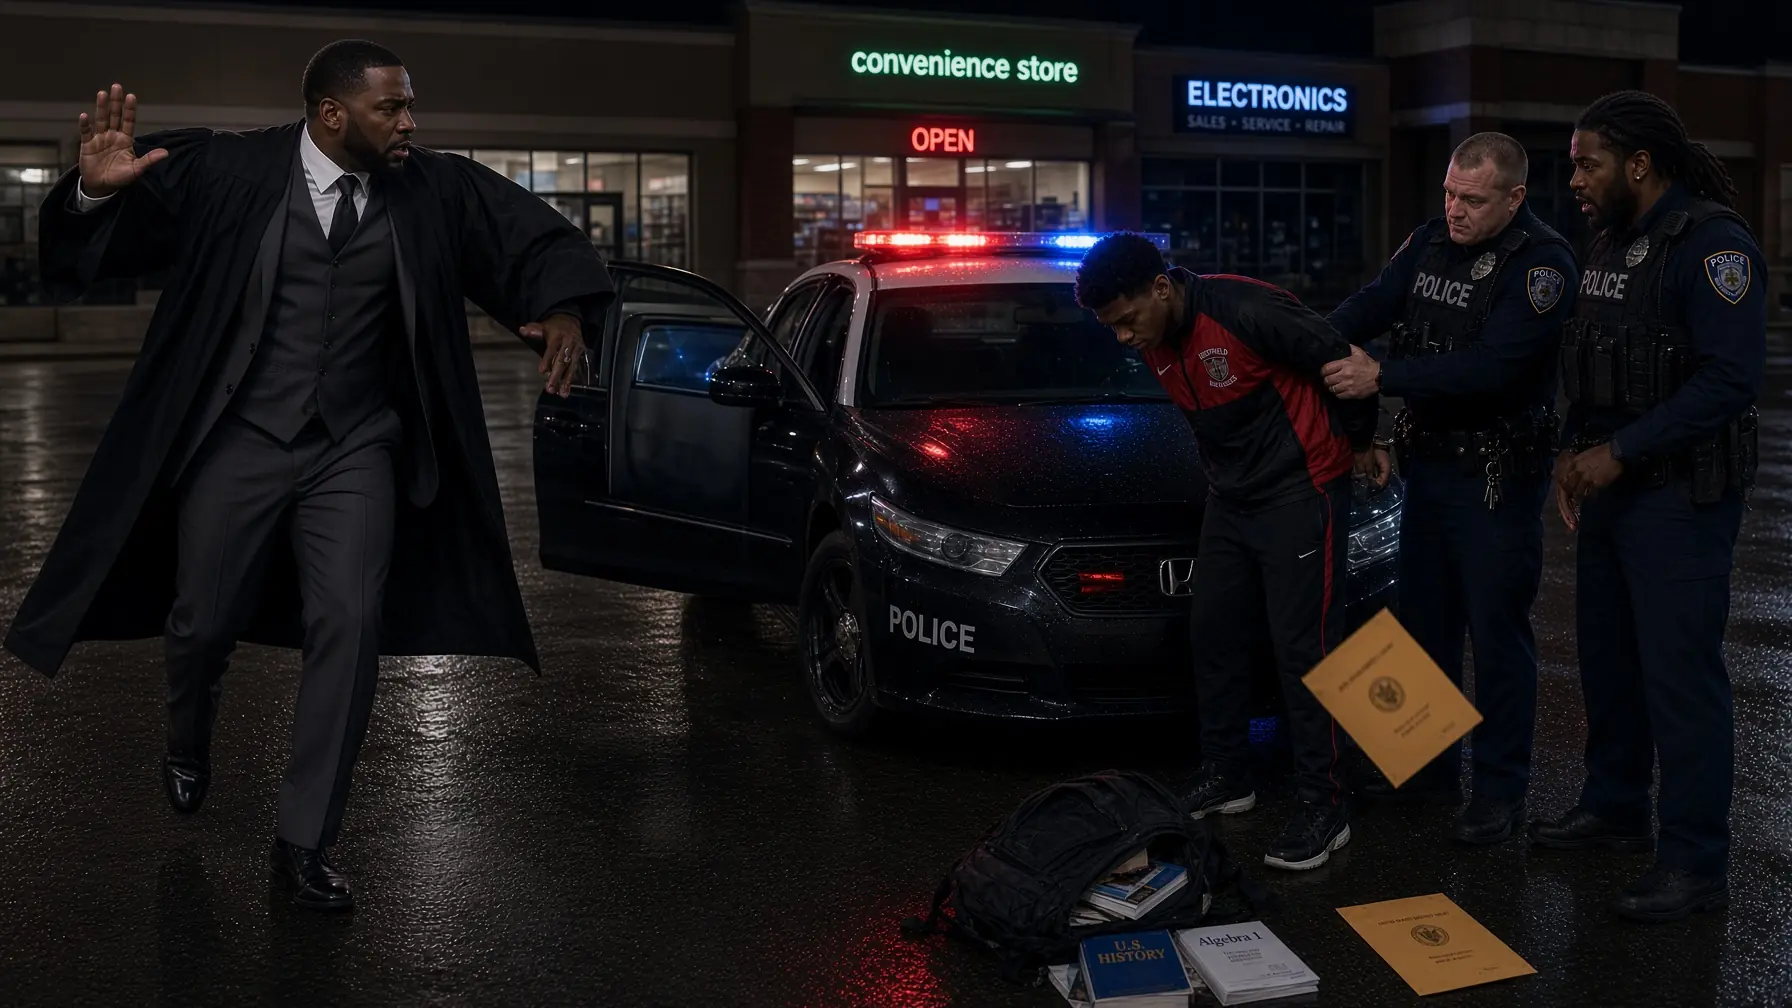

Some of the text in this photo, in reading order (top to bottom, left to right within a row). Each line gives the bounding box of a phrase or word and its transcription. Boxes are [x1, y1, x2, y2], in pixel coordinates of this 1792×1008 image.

[851, 48, 1079, 83] convenience store
[1187, 80, 1348, 112] ELECTRONICS
[1187, 114, 1346, 133] SALES SERVICE REPAIR
[911, 126, 975, 153] OPEN
[1710, 254, 1745, 268] POLICE
[1413, 271, 1474, 308] POLICE
[1580, 270, 1629, 300] POLICE
[889, 604, 976, 654] POLICE
[1113, 939, 1146, 951] U.S.
[1199, 931, 1263, 947] Algebra 1
[1097, 948, 1165, 964] HISTORY
